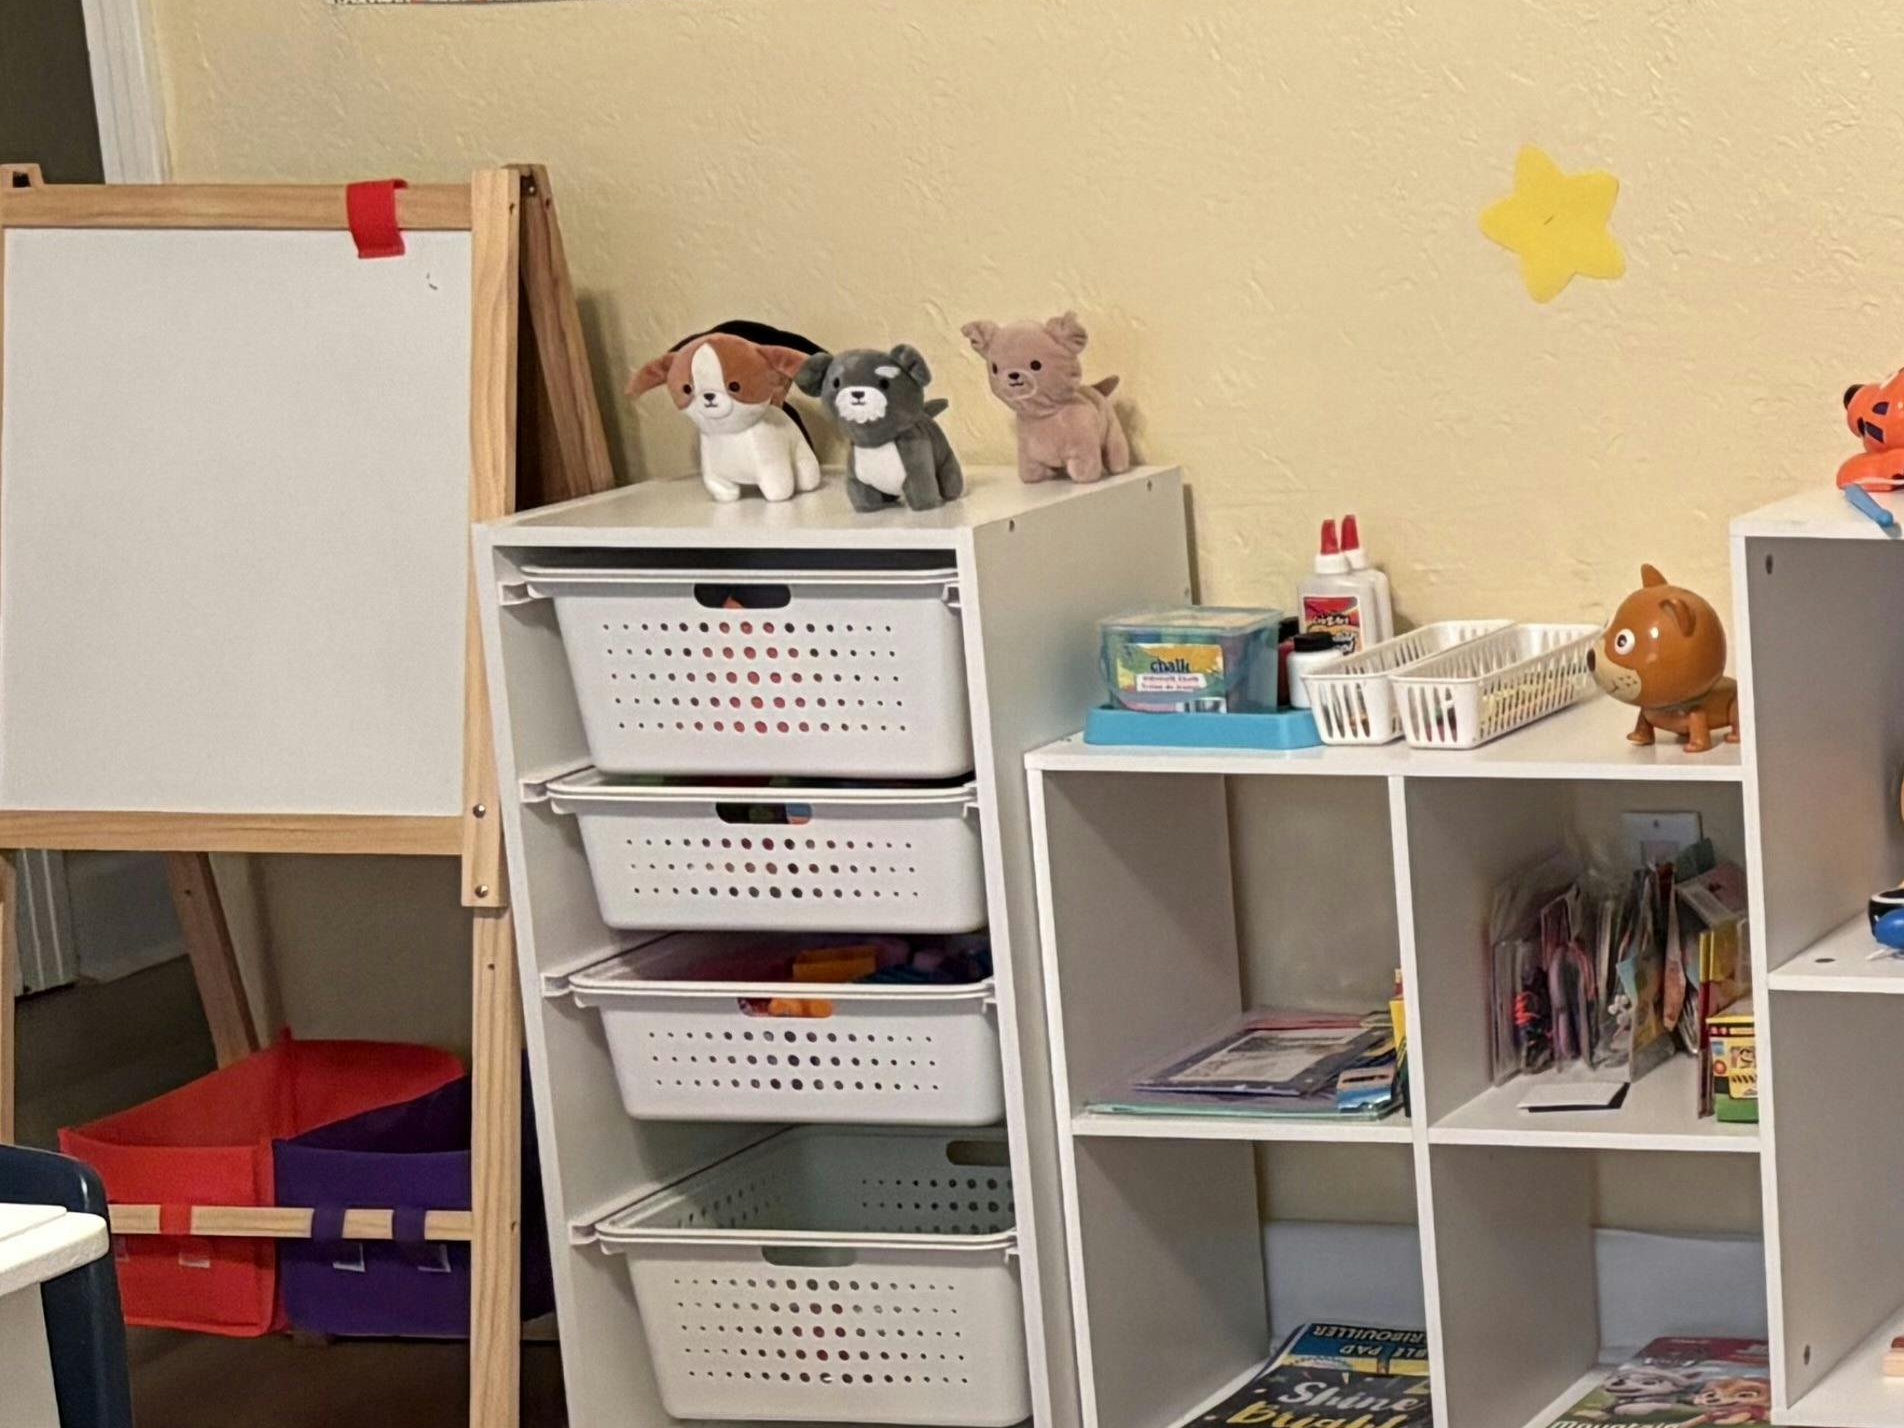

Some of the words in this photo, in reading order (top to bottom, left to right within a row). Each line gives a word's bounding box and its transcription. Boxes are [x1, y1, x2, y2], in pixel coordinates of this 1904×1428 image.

[1150, 658, 1190, 673] chalk
[1313, 1325, 1427, 1344] RIBOUILLER
[1339, 1345, 1382, 1356] PAD
[1277, 1381, 1420, 1411] Shine
